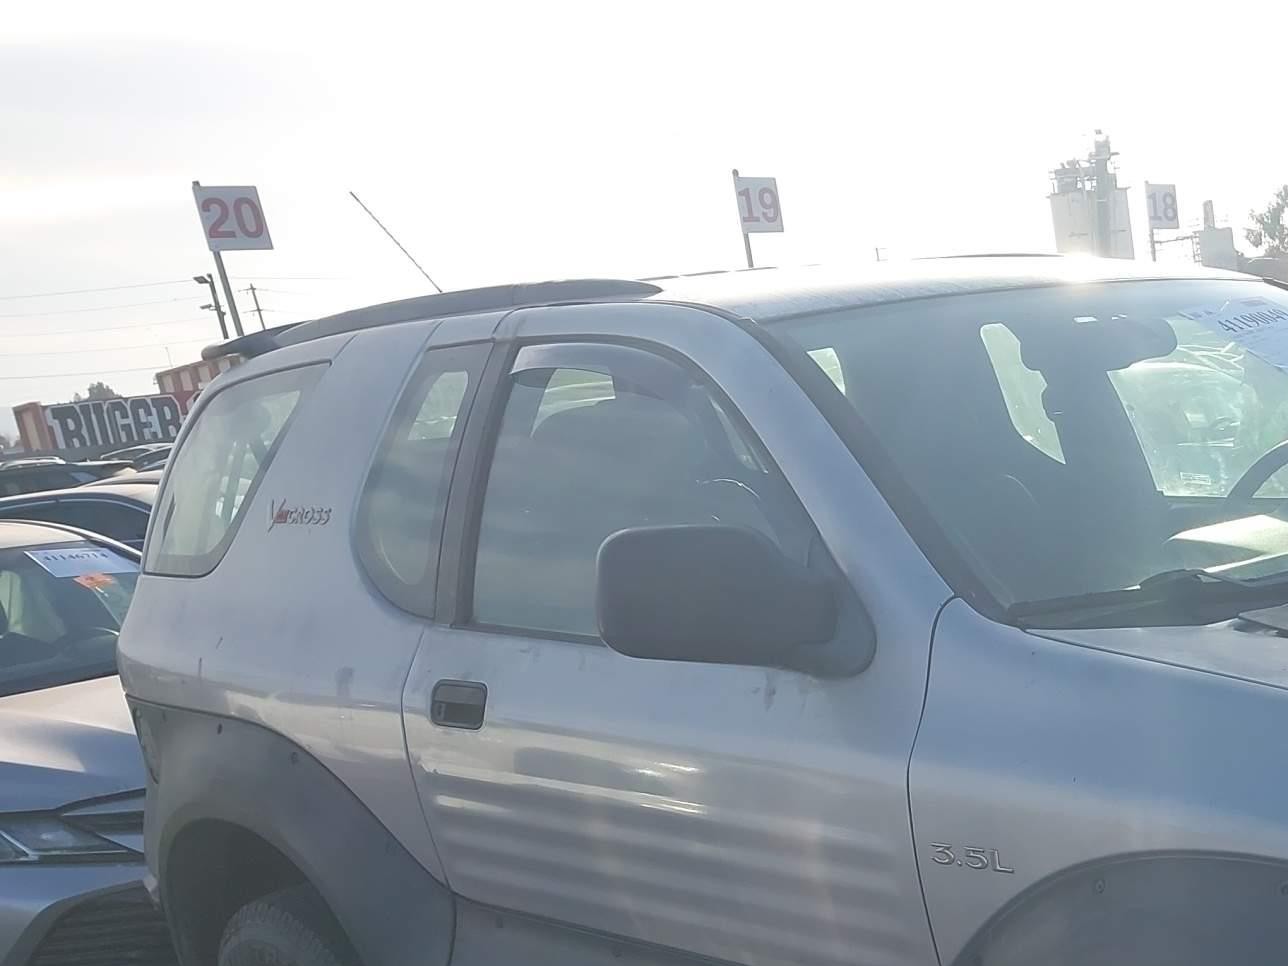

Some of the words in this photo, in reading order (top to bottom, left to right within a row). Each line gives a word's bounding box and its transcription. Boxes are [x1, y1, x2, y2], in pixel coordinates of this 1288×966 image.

[201, 197, 263, 238] 20
[738, 187, 778, 223] 19
[1147, 191, 1177, 221] 18
[930, 842, 1015, 874] 3.5L
